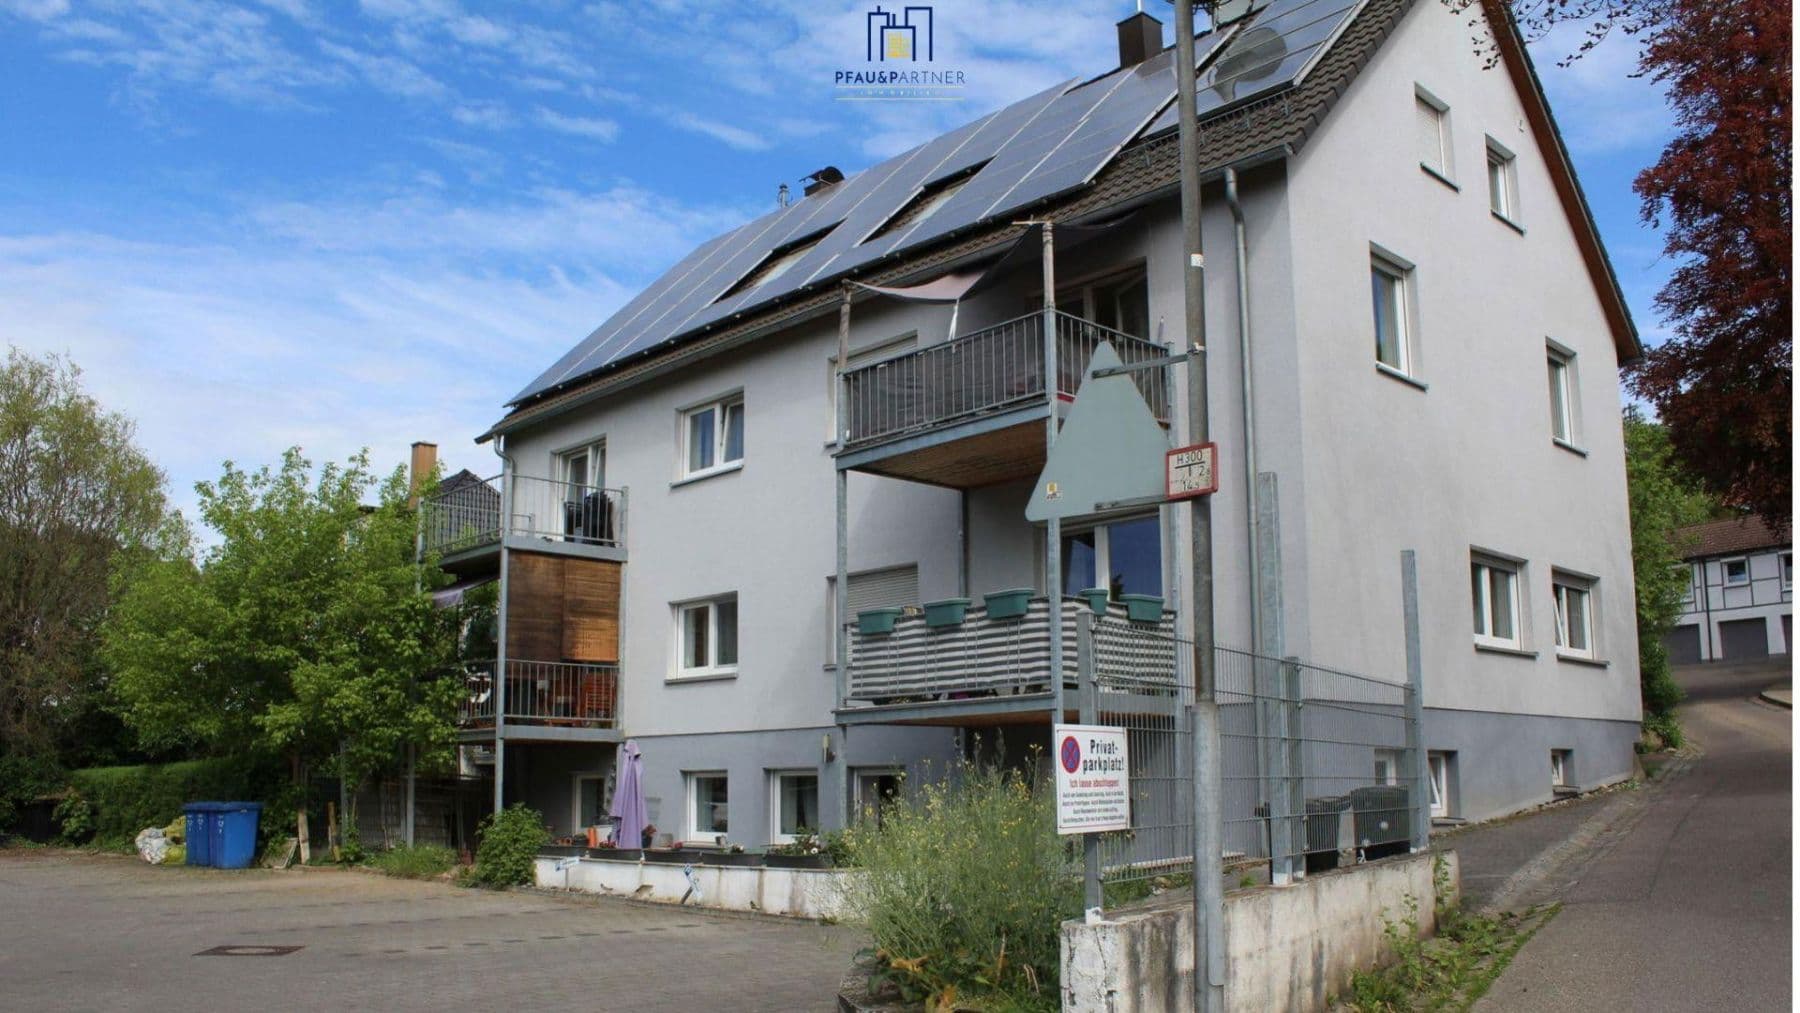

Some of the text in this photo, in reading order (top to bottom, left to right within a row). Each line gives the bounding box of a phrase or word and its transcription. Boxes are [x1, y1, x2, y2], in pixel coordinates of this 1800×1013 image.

[1176, 449, 1203, 465] H300
[1090, 739, 1118, 754] Privat-
[1083, 757, 1124, 775] parkplatz!
